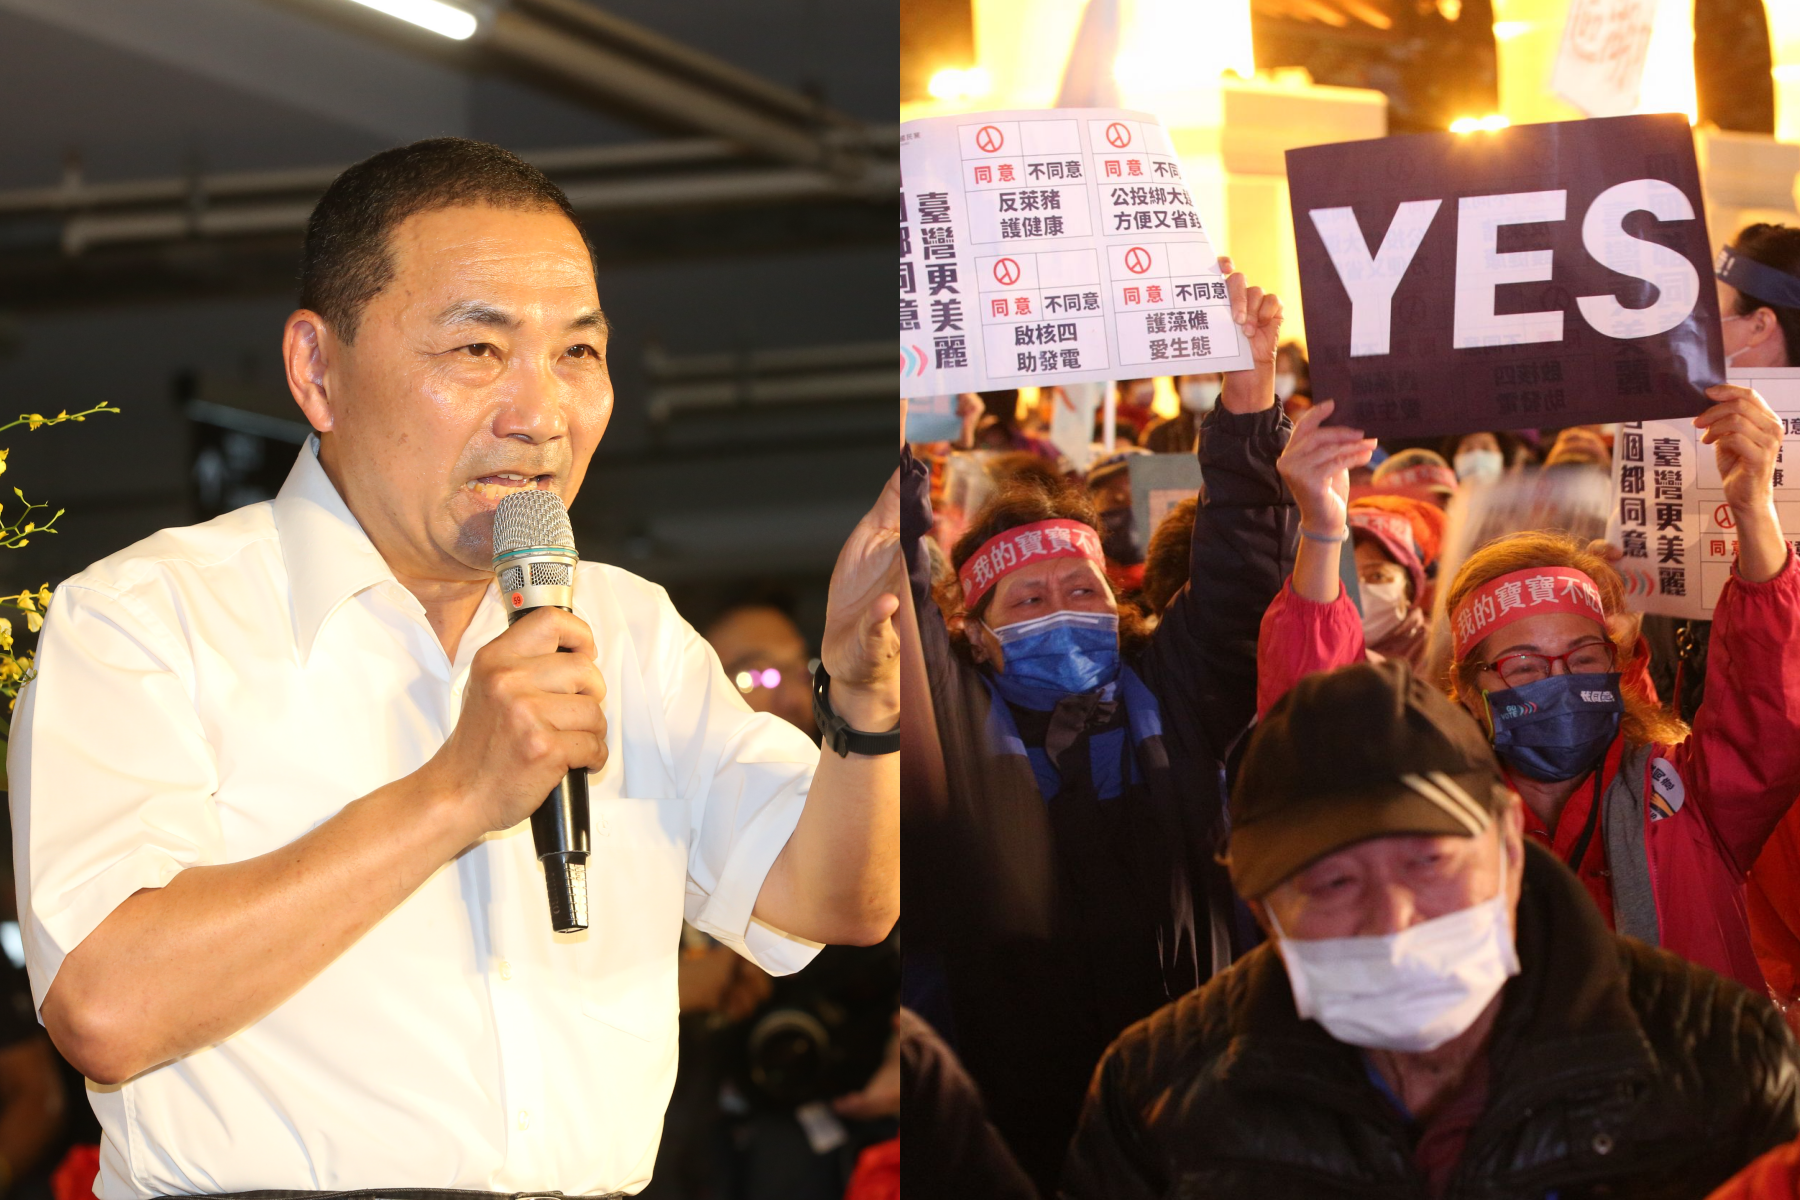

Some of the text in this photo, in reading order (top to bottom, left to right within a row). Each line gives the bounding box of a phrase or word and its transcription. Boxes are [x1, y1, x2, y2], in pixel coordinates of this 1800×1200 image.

[974, 164, 1015, 184] 同意
[1027, 160, 1083, 180] 不同意
[1104, 159, 1143, 177] 同意
[1152, 161, 1181, 180] 不同
[998, 189, 1061, 212] 反萊豬
[1000, 215, 1064, 239] 護健康
[1308, 178, 1700, 358] YES
[916, 192, 969, 369] 臺灣更美麗
[1174, 282, 1228, 302] 不同意
[991, 296, 1032, 317] 同意
[1044, 292, 1100, 313] 不同意
[1123, 285, 1163, 305] 同意
[1145, 310, 1209, 334] 護藻礁
[1014, 323, 1078, 346] 啟核四
[1149, 335, 1211, 361] 愛生態
[1017, 348, 1082, 373] 助發電
[1652, 438, 1686, 596] 臺灣更美麗
